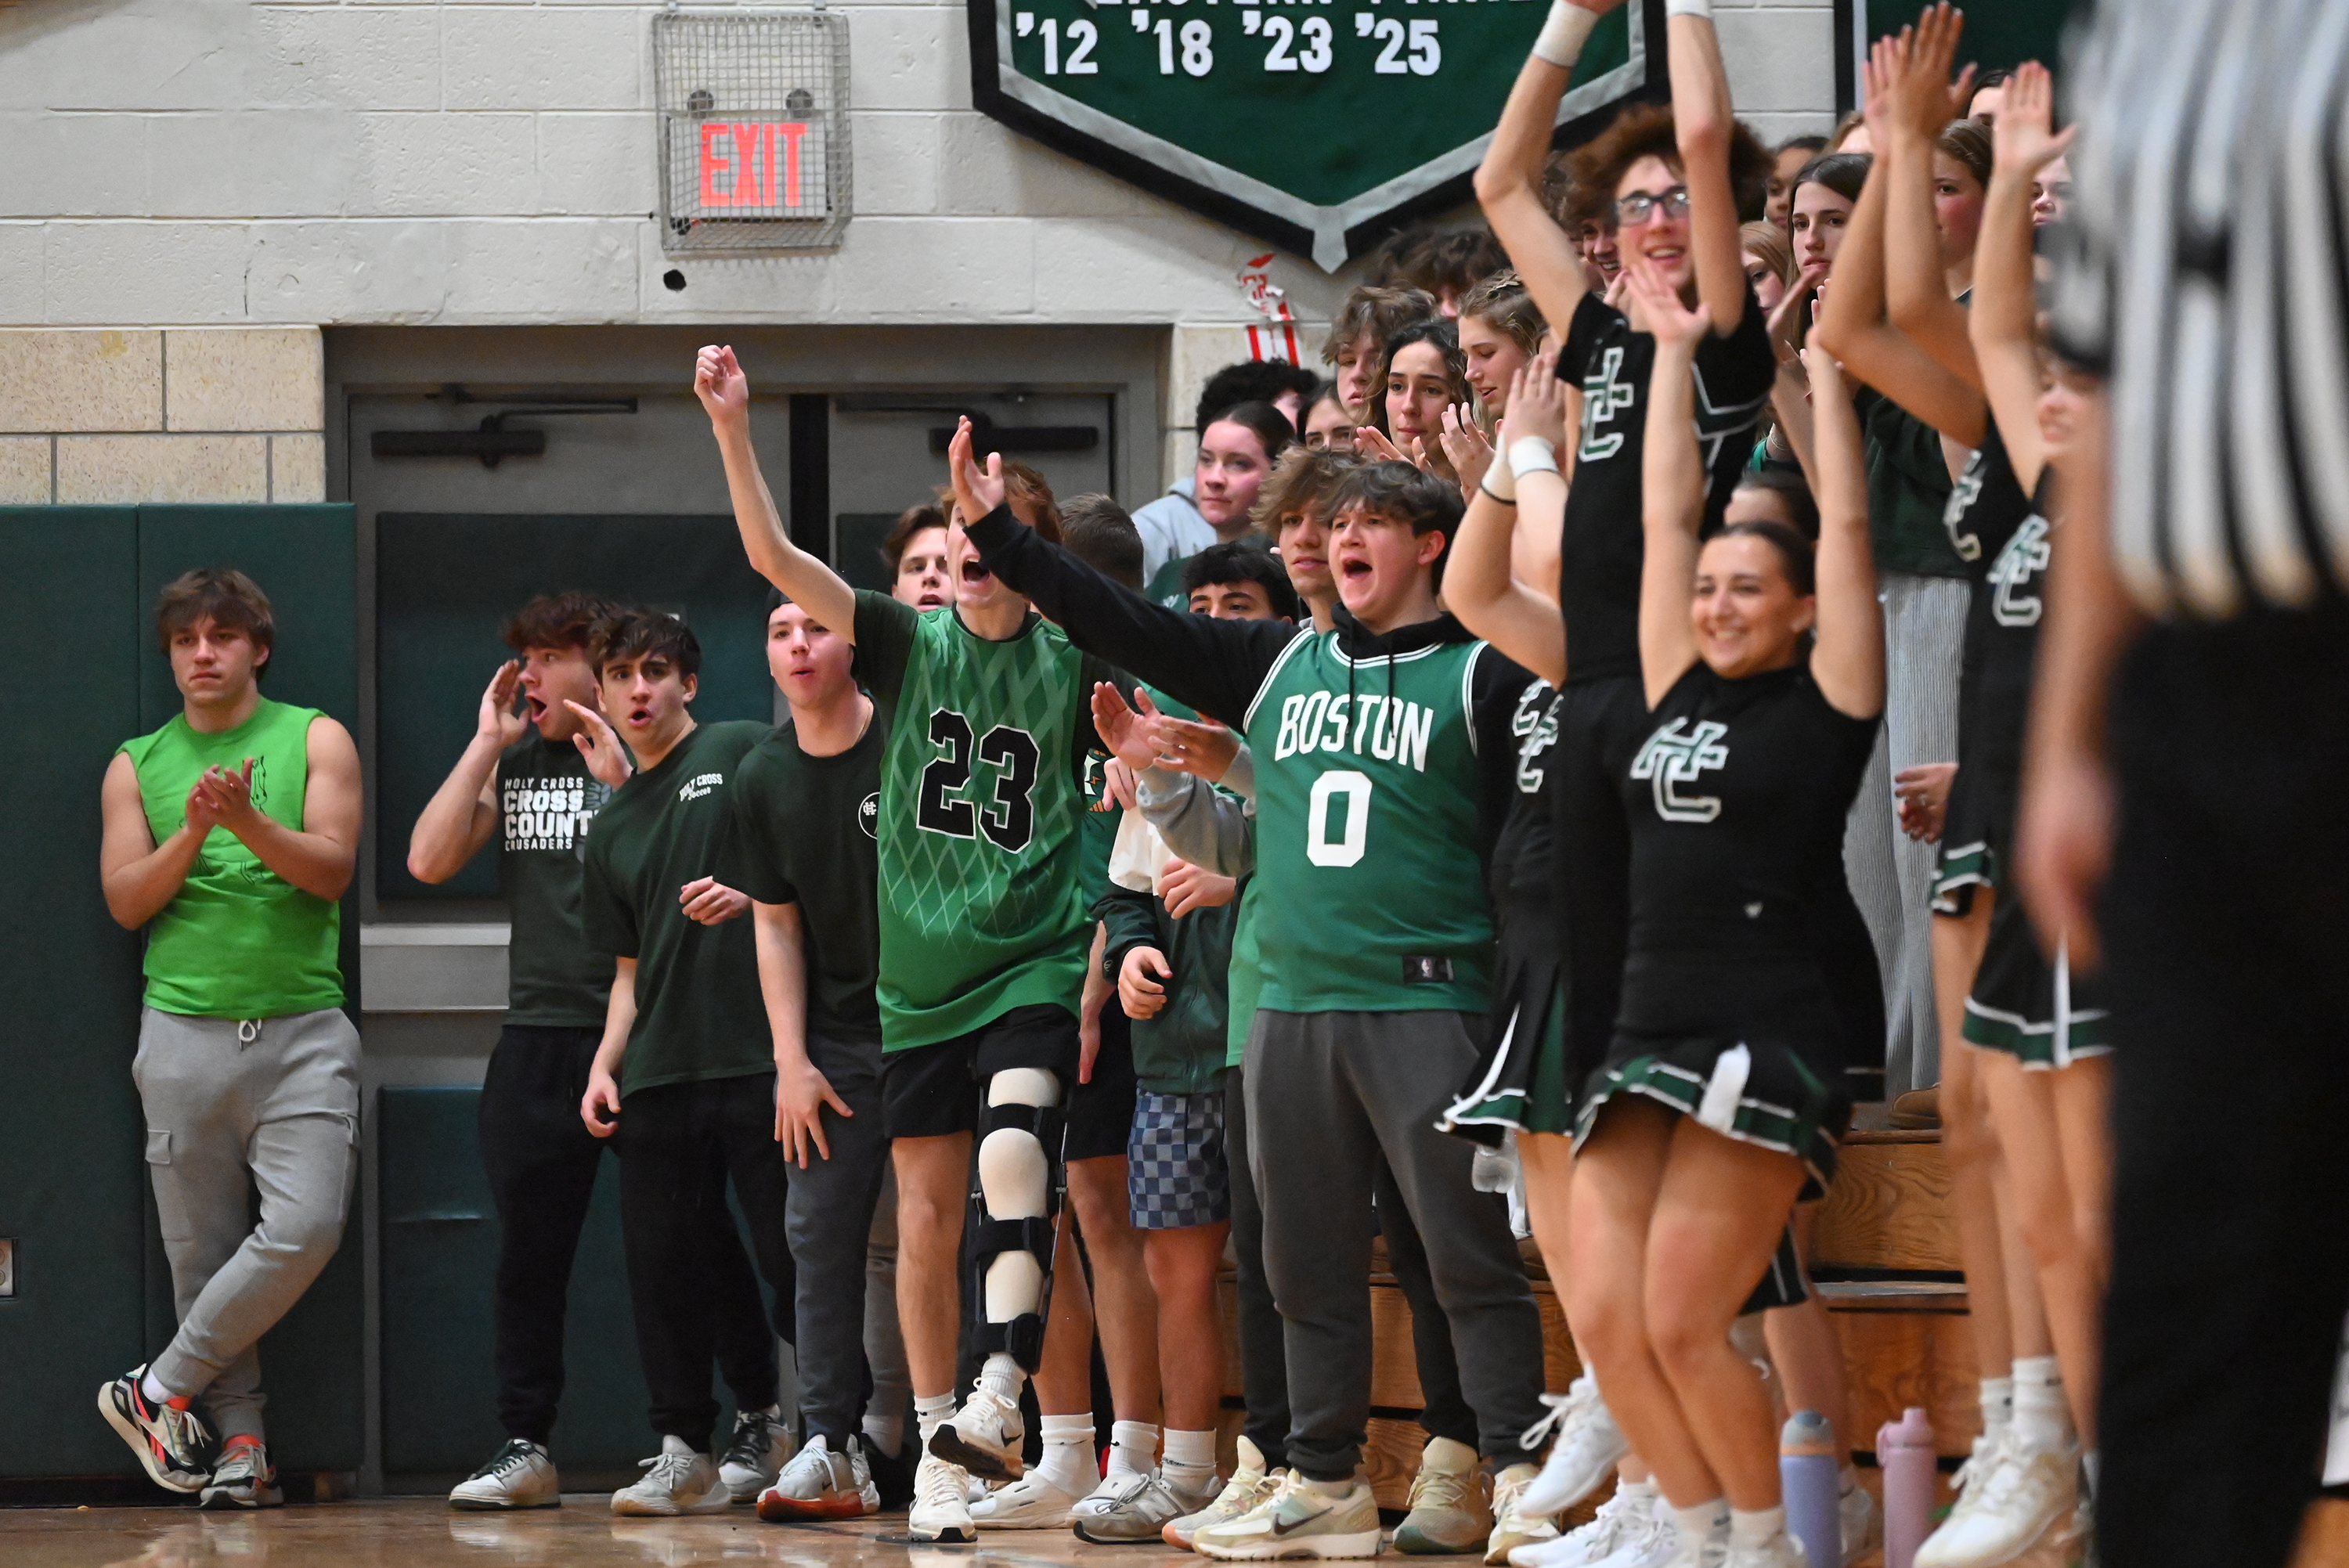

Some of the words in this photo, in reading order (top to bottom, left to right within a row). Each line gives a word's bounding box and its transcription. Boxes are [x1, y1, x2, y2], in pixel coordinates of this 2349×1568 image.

[700, 123, 807, 207] EXIT
[1275, 690, 1434, 773] BOSTON
[504, 777, 534, 791] HOLY
[540, 777, 584, 790] CROSS
[696, 773, 723, 787] CROSS
[916, 706, 1041, 854] 23
[503, 790, 584, 813] CROSS
[505, 809, 599, 839] COUNT
[1307, 770, 1373, 867] 0
[504, 838, 572, 852] CRUSADERS
